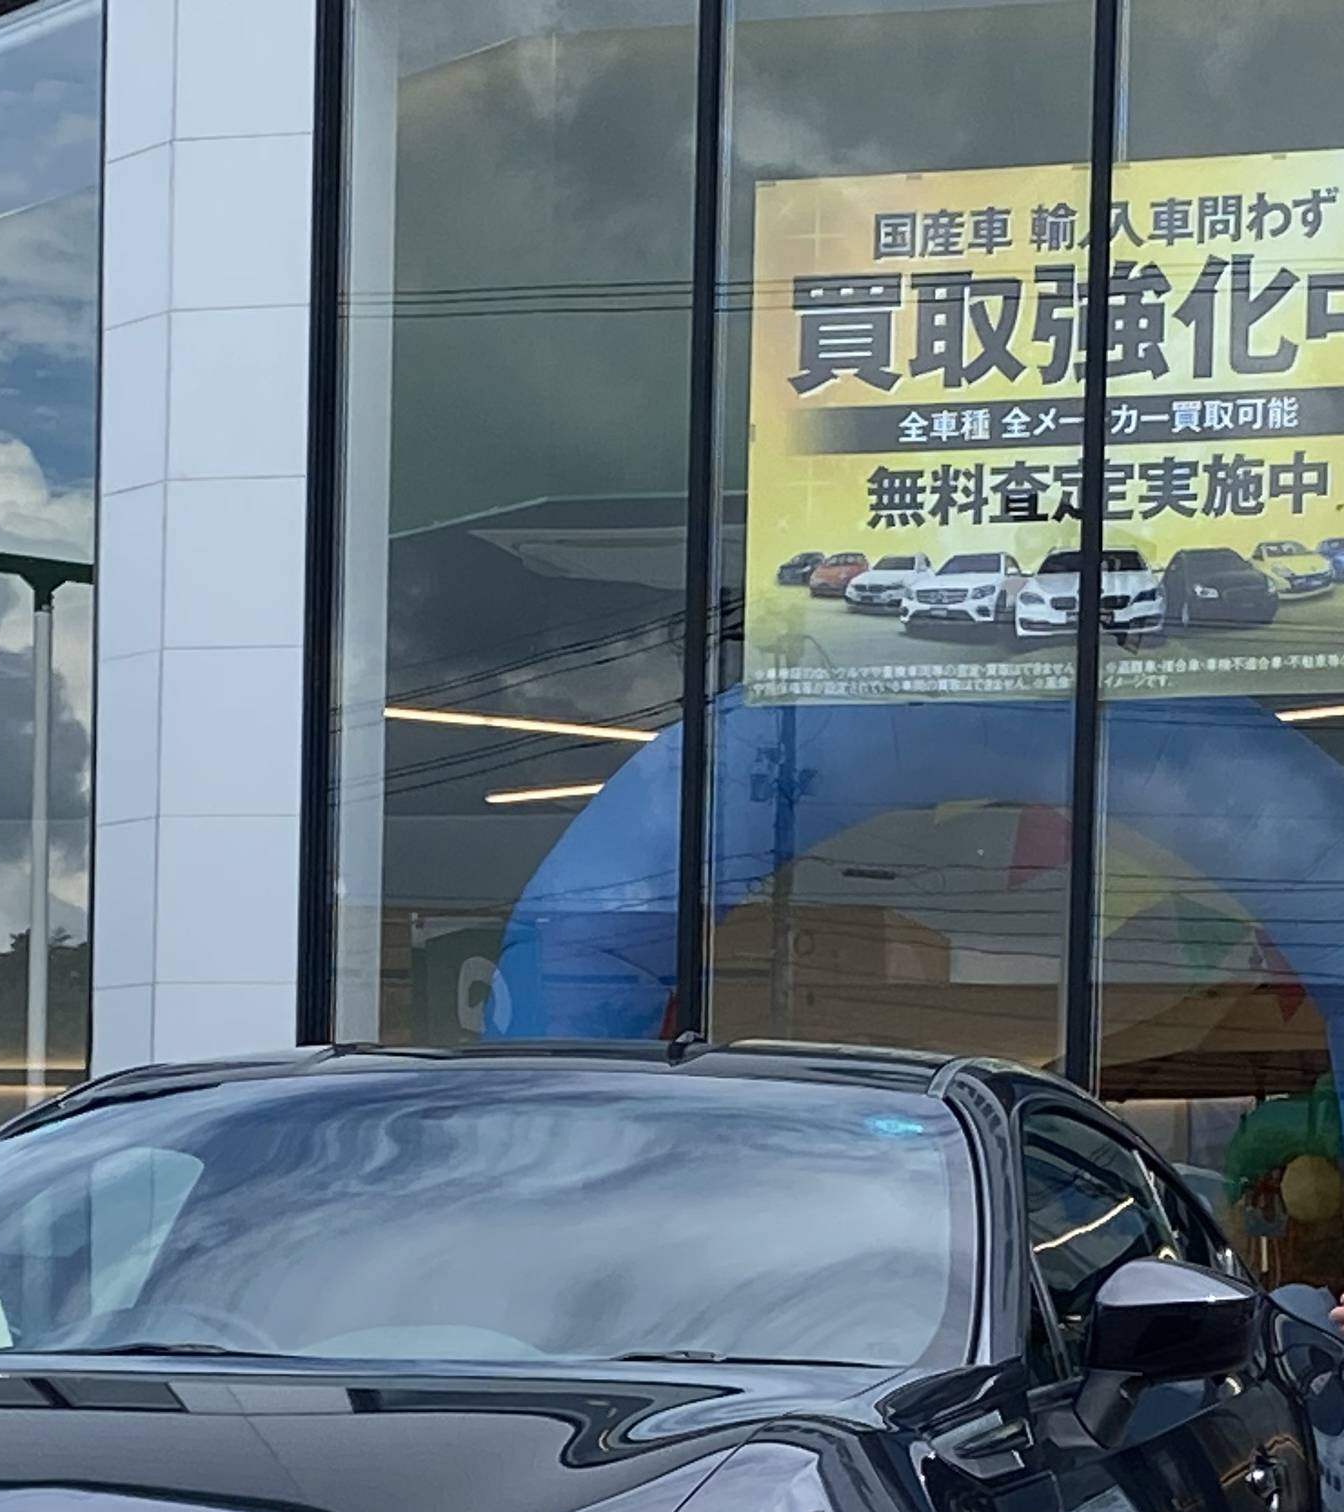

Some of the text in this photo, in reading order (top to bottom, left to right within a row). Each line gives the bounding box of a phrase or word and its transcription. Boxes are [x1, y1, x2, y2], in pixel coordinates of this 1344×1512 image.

[872, 186, 1340, 261] 国産車 輸入車問わず
[897, 408, 992, 443] 全車種
[865, 450, 1329, 530] 無料査定実施中
